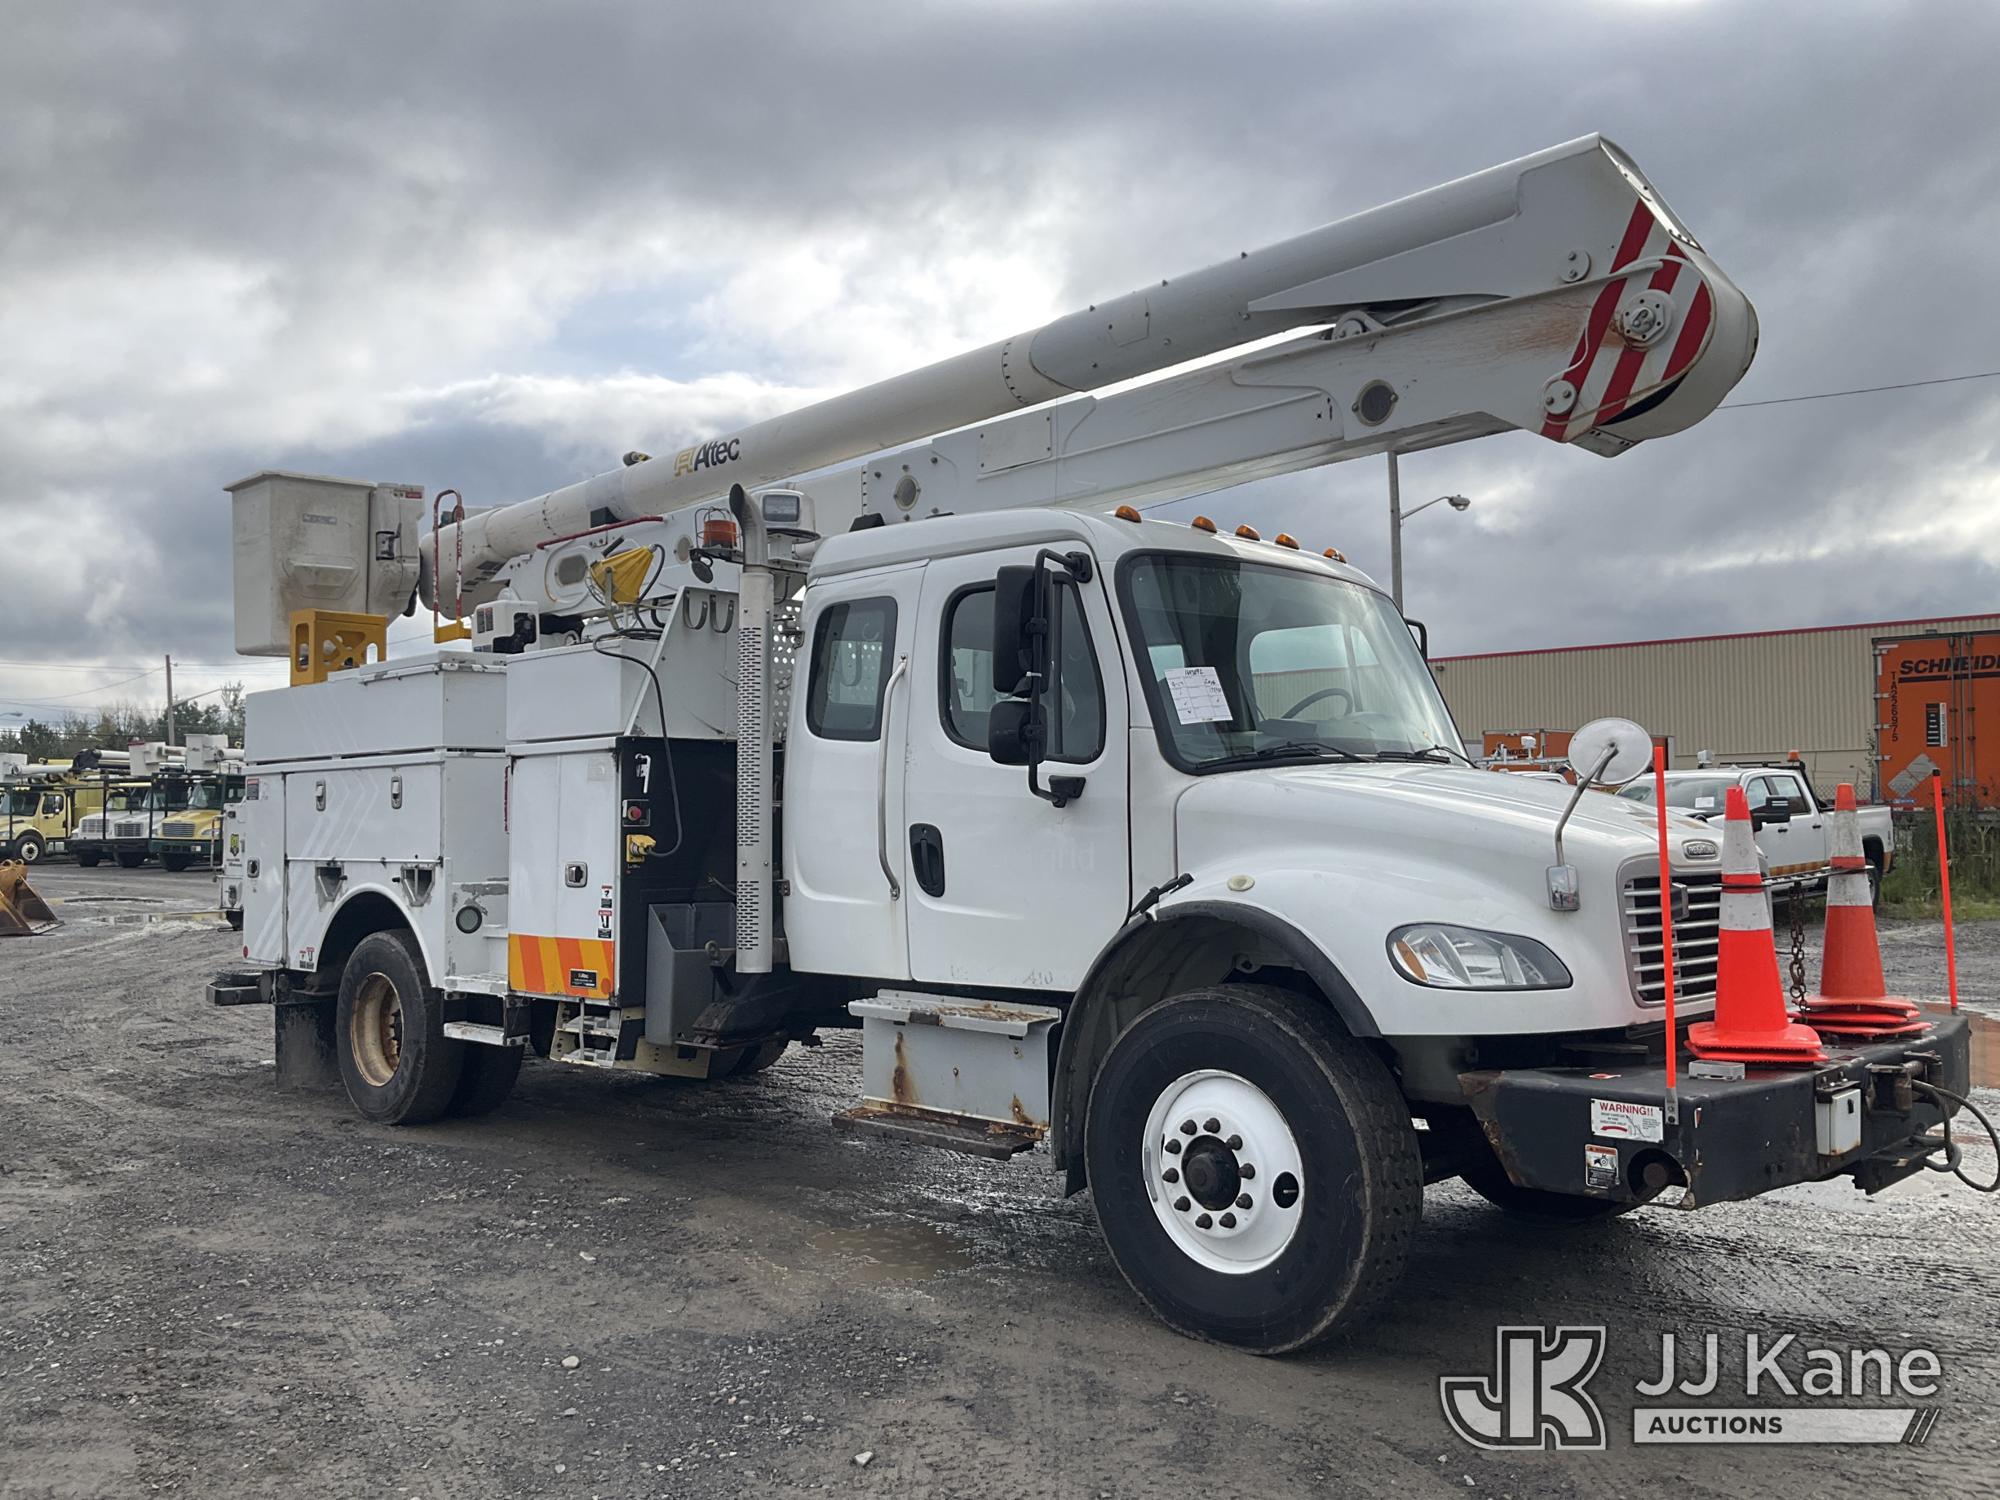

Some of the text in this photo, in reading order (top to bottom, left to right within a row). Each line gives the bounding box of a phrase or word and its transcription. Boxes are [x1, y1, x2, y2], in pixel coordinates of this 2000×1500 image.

[694, 438, 740, 471] Altec
[1900, 655, 2000, 675] SCHNEID
[1600, 1102, 1653, 1117] WARNING!!
